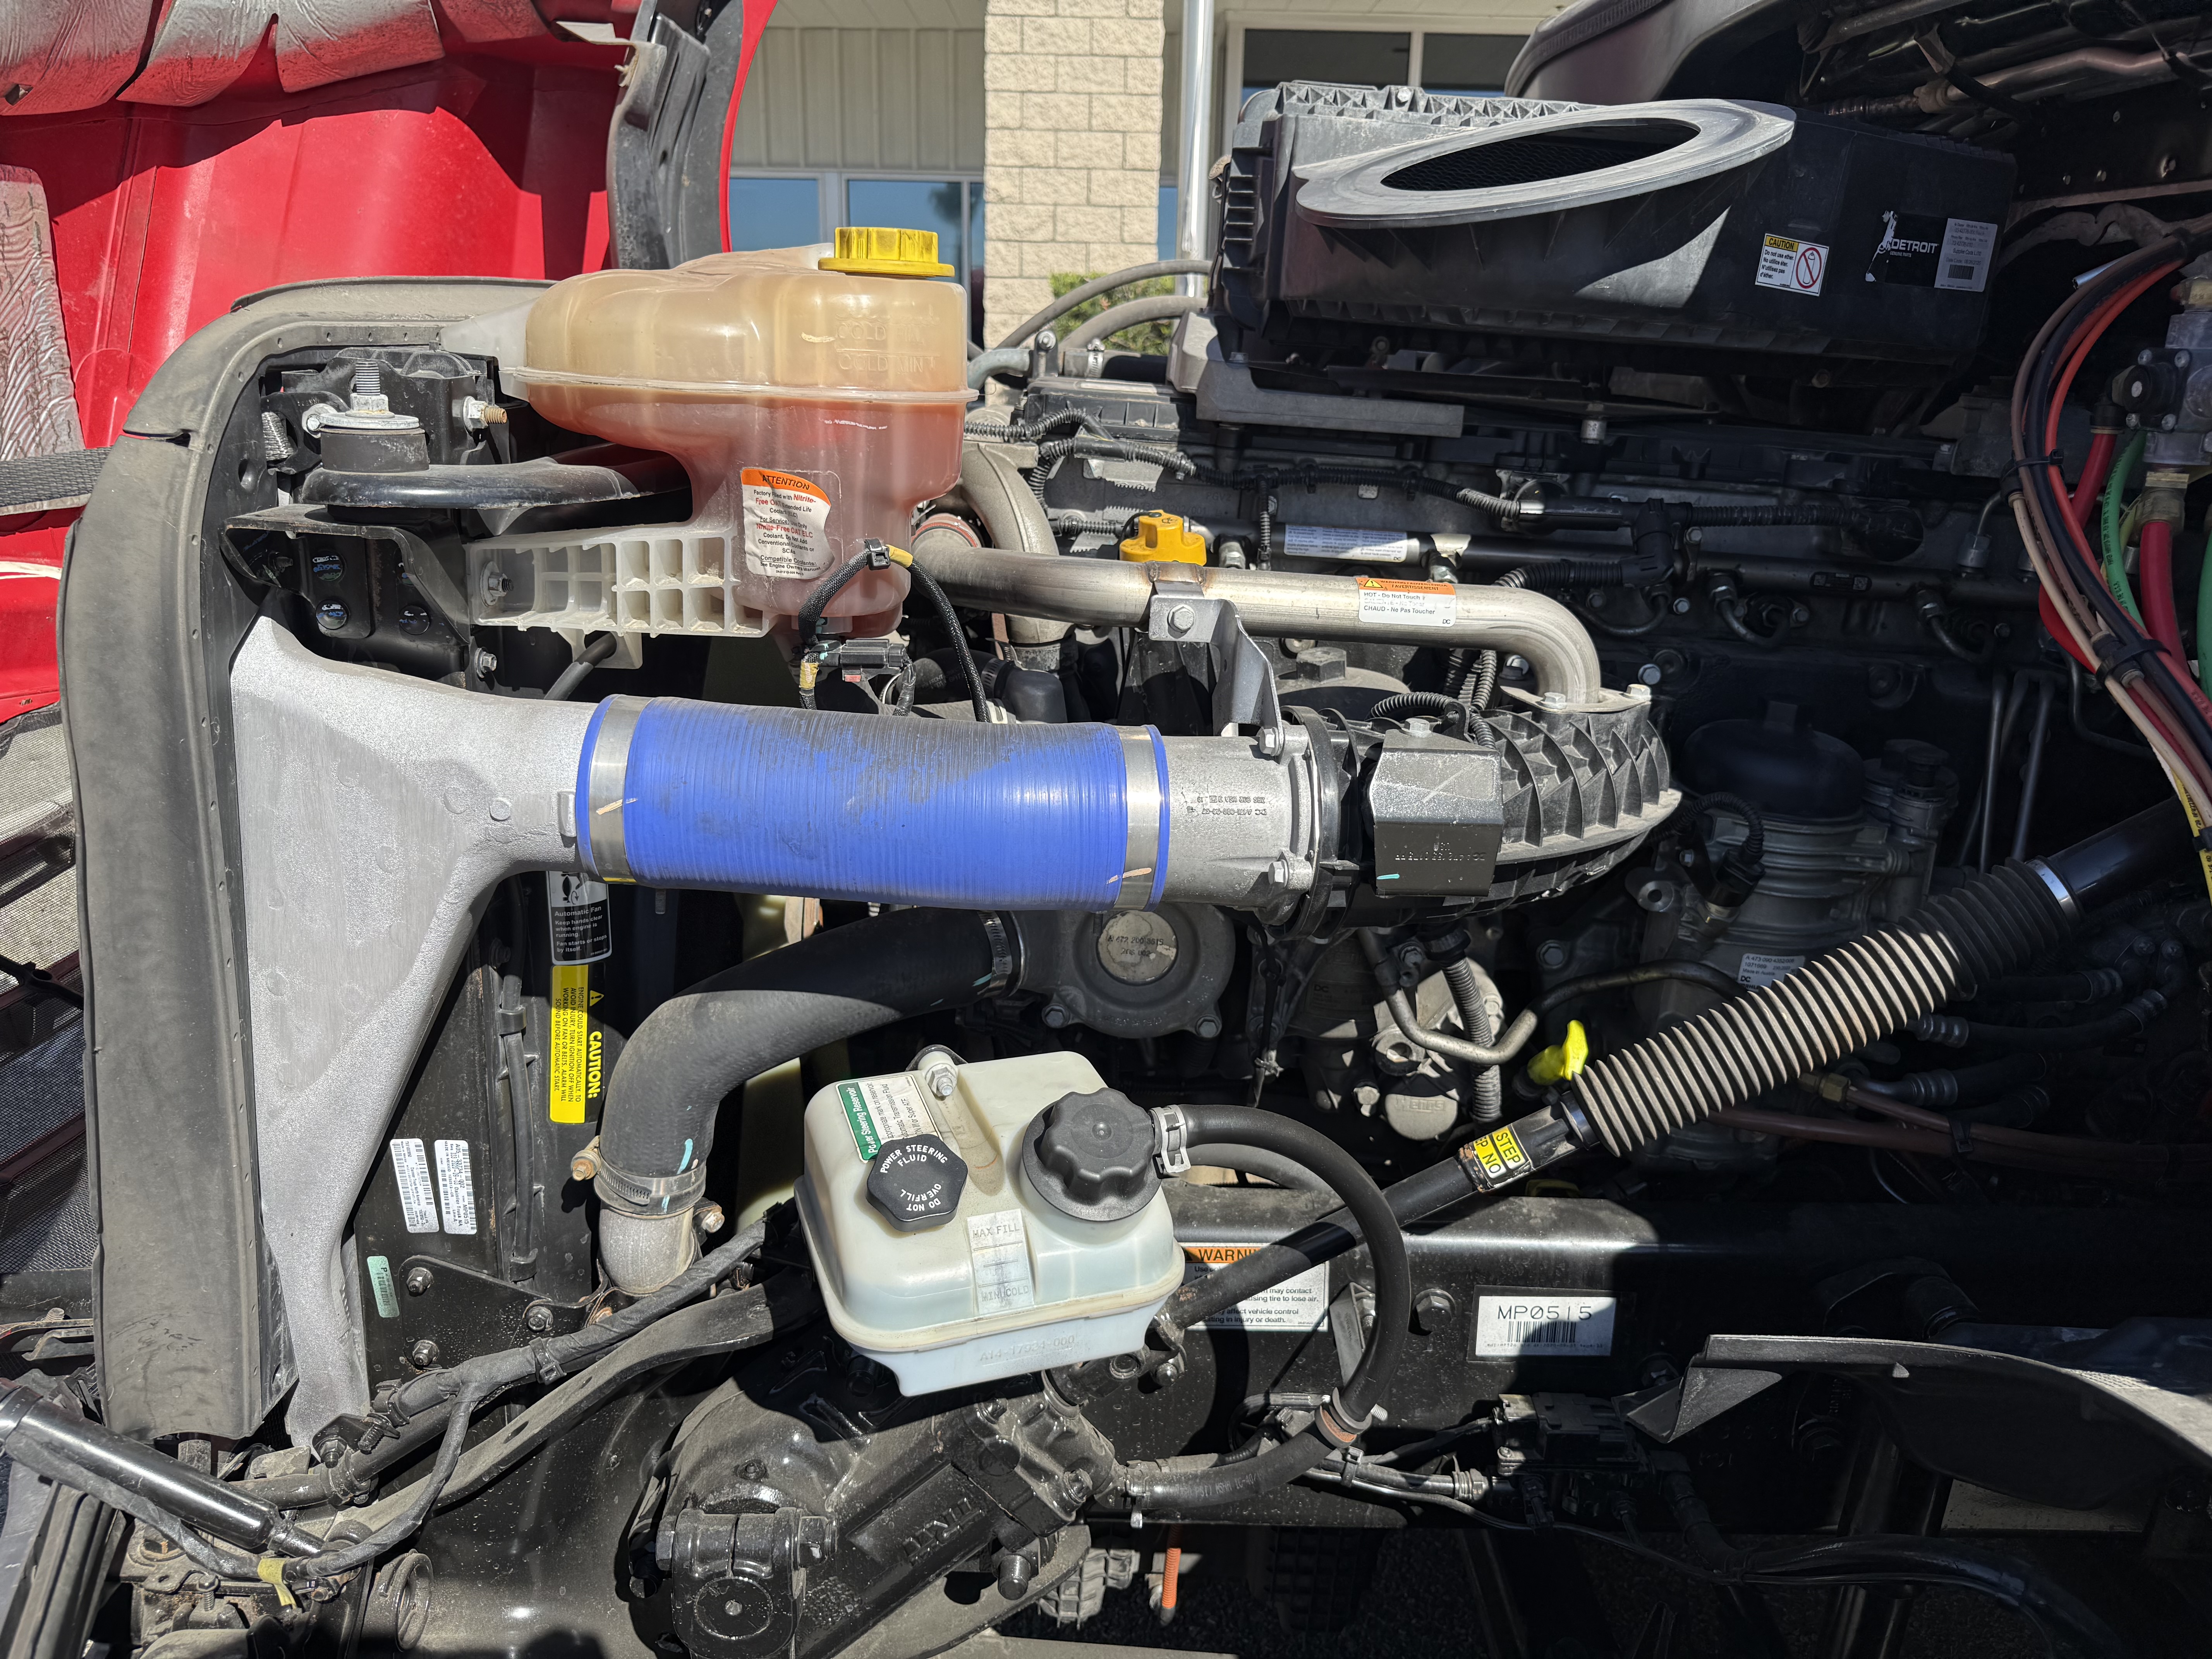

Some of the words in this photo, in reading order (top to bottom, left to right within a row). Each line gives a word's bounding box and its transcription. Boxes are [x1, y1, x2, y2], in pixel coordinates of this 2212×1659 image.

[1769, 238, 1794, 250] CAUTION
[1891, 239, 1939, 253] DETROIT
[839, 354, 888, 371] COLD
[762, 475, 810, 490] ATTENTION
[791, 528, 801, 536] OAT
[1314, 984, 1329, 993] DC
[562, 1018, 568, 1027] ON
[587, 1031, 602, 1099] CAUTION:
[846, 1087, 862, 1112] Reservoir
[887, 1093, 901, 1120] Transmission
[857, 1112, 872, 1136] Steering
[865, 1134, 878, 1153] Power
[1496, 1132, 1521, 1163] STEP
[880, 1149, 902, 1173] POWER
[905, 1144, 948, 1163] STEERING
[897, 1154, 927, 1167] FLUID
[1482, 1154, 1501, 1173] NO
[900, 1183, 941, 1201] OVERFILL
[929, 1198, 941, 1209] DO
[972, 1228, 993, 1238] MAX
[997, 1223, 1020, 1234] FILL
[1005, 1285, 1029, 1297] COLD
[1498, 1305, 1592, 1320] MP0515
